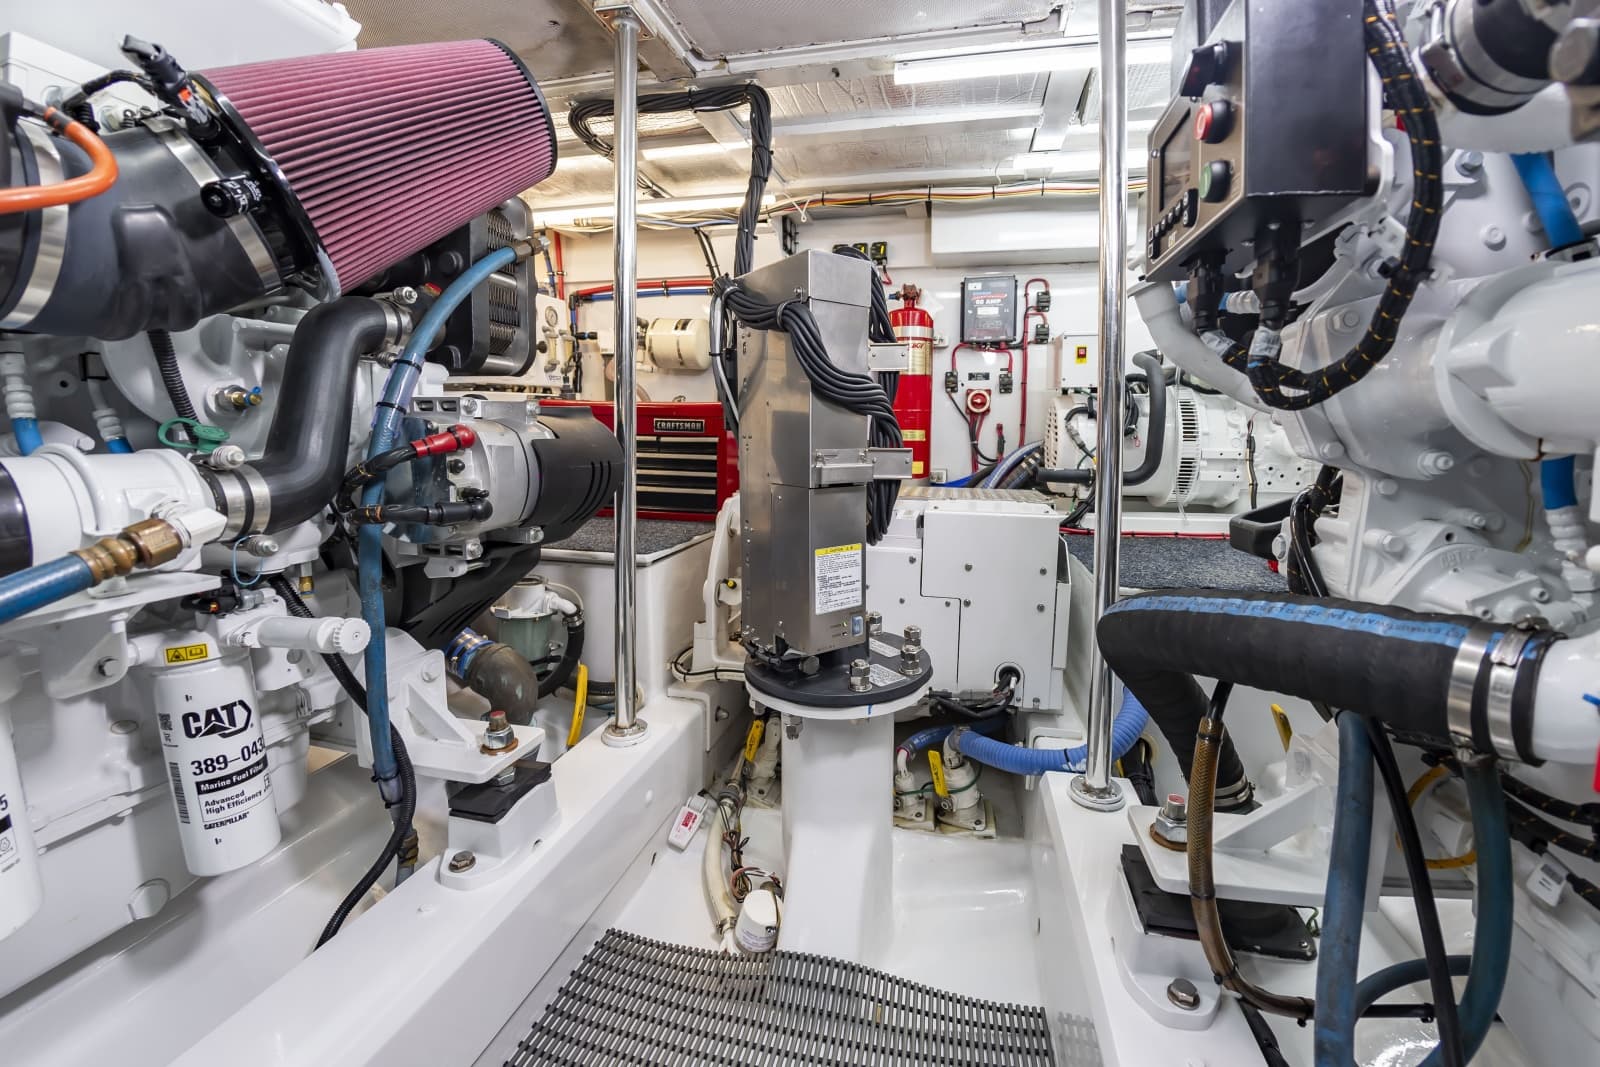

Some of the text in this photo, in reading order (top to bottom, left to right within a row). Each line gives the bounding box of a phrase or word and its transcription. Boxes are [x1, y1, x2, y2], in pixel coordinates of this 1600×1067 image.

[656, 421, 702, 430] CRAFTSMAN
[182, 700, 239, 738] CAT
[200, 762, 264, 791] Marine Fuel Filter
[205, 790, 245, 807] Advanced
[206, 790, 262, 815] High Efficiency
[204, 813, 248, 830] CATERPILLAR
